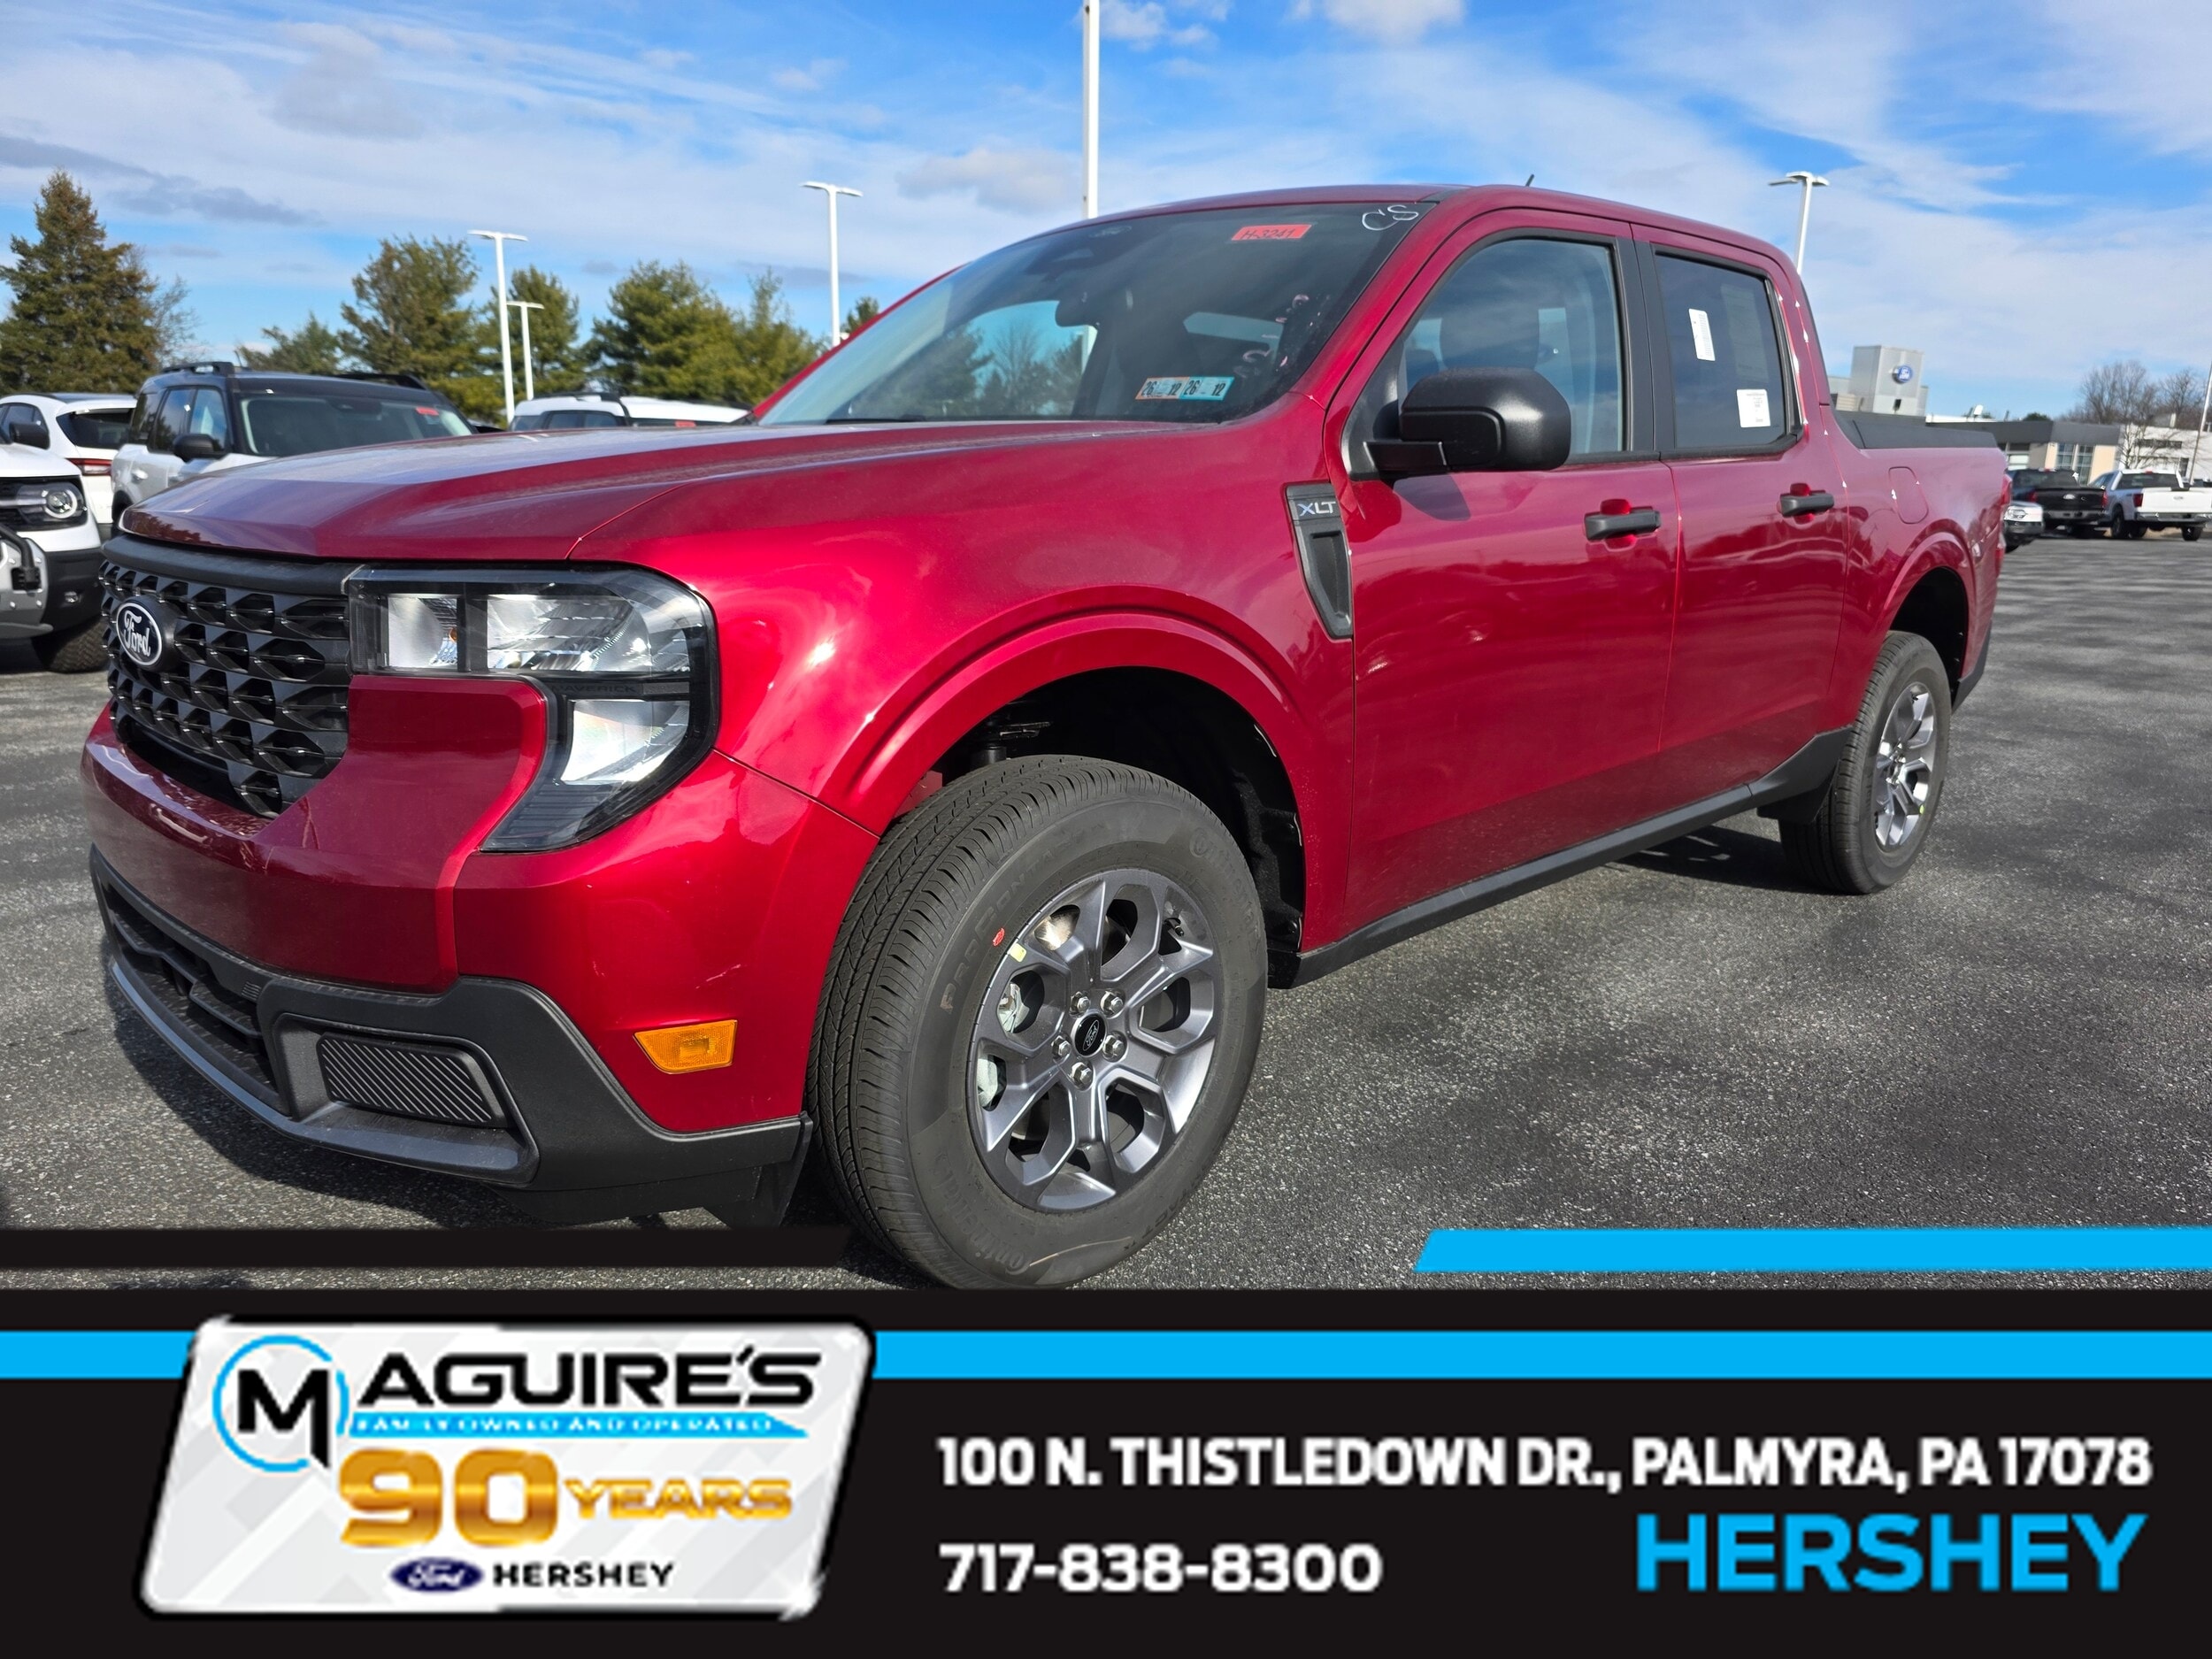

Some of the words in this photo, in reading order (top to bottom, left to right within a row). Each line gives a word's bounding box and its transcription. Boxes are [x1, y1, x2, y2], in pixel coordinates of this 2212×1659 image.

[1141, 380, 1157, 396] 26
[1168, 382, 1182, 396] 12
[1184, 380, 1200, 396] 26
[1211, 382, 1226, 396] 12
[1297, 501, 1337, 517] XLT
[124, 610, 151, 657] Ford
[552, 684, 637, 694] MAVERICK
